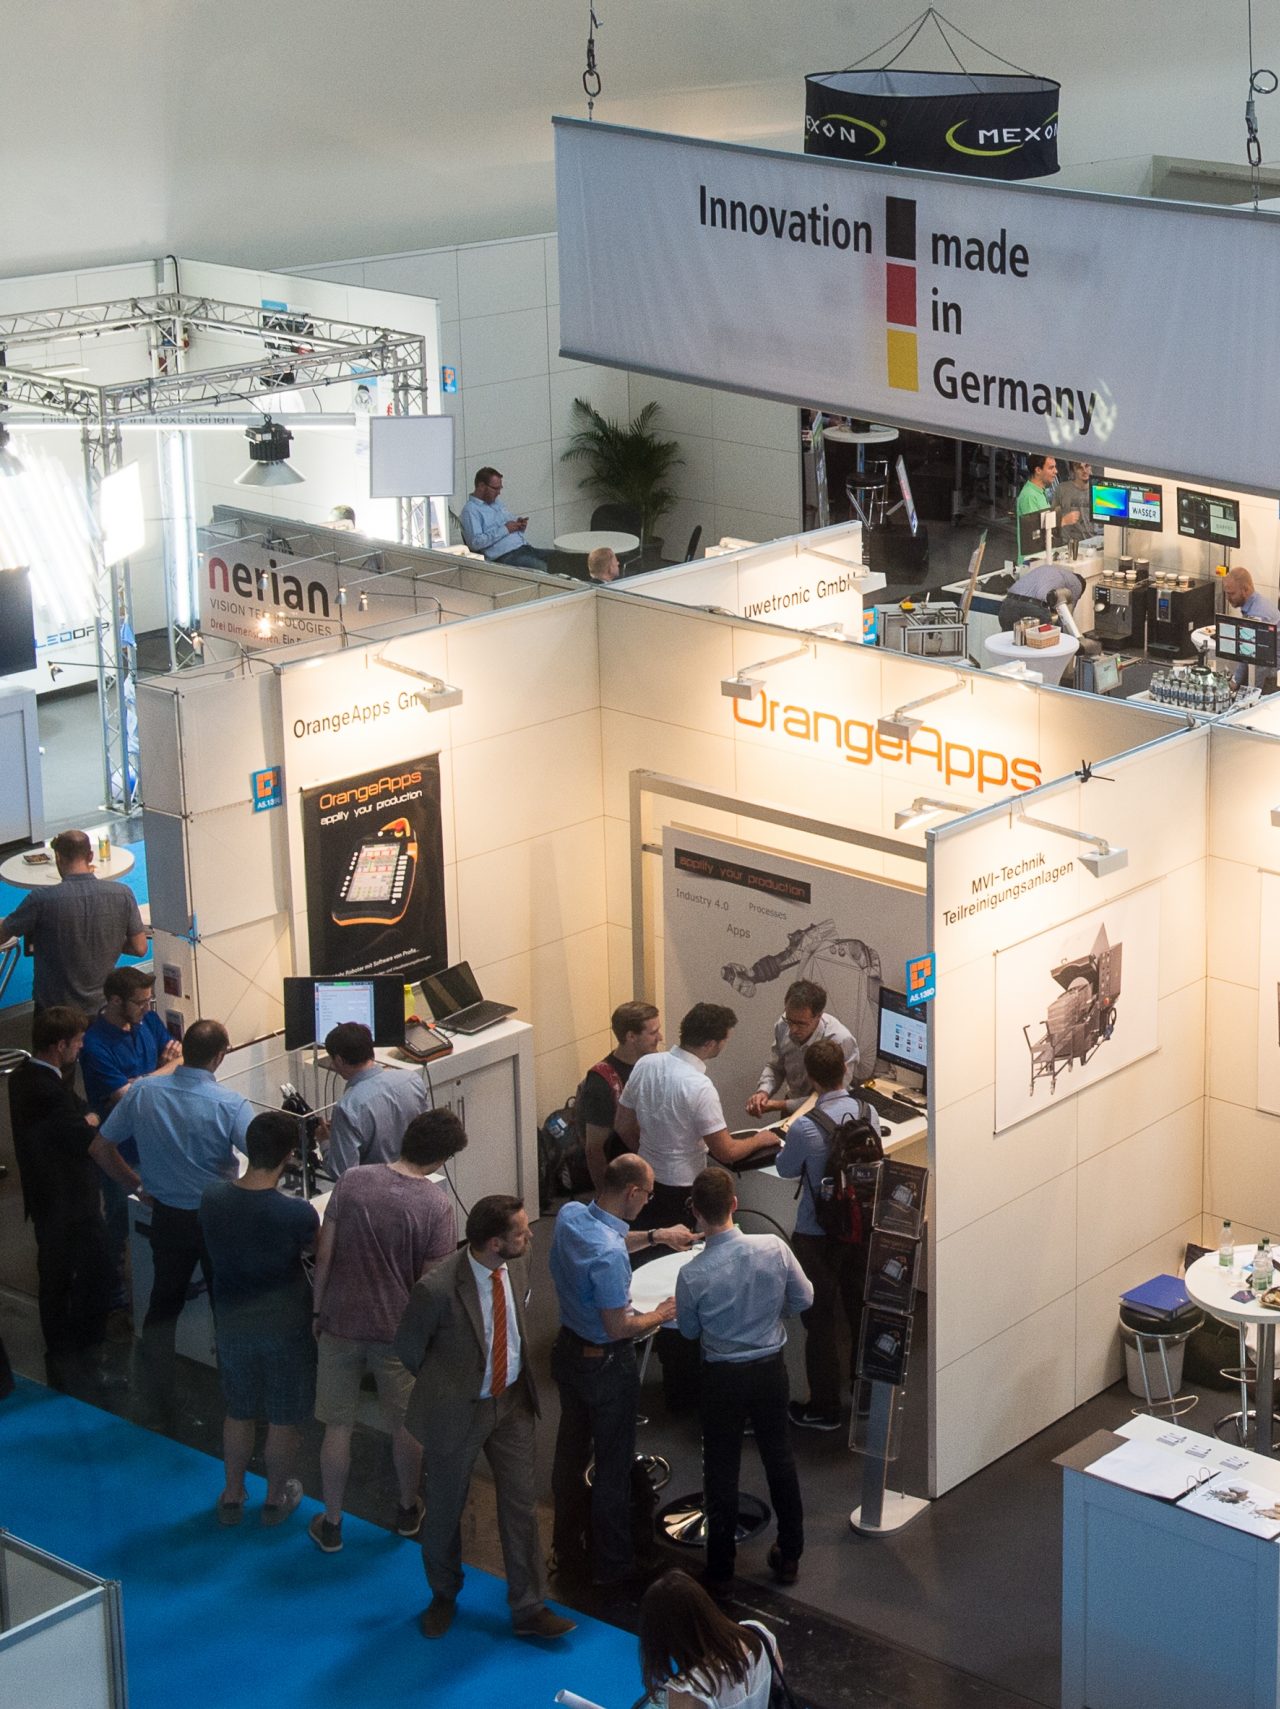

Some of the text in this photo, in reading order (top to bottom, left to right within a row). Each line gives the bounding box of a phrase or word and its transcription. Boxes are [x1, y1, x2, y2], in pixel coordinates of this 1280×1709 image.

[806, 115, 856, 143] EXON
[700, 186, 1029, 278] Innovation made
[932, 287, 962, 335] in
[933, 358, 1095, 435] Germany
[209, 557, 329, 617] nerian
[744, 587, 810, 619] uwetronic
[210, 597, 331, 636] VISION TECNOLOGIES
[294, 700, 390, 738] OrangeApps
[733, 688, 1042, 792] OrangeApps
[320, 771, 422, 810] OrangeApps
[354, 804, 373, 819] your
[376, 789, 423, 811] production
[720, 867, 743, 882] your
[748, 874, 805, 897] production
[972, 852, 1045, 895] MVI-Technik
[676, 888, 729, 911] Industry 4.0
[749, 902, 787, 921] Processes
[943, 862, 1074, 926] Teilreinigungsanlagen
[727, 923, 750, 939] Apps
